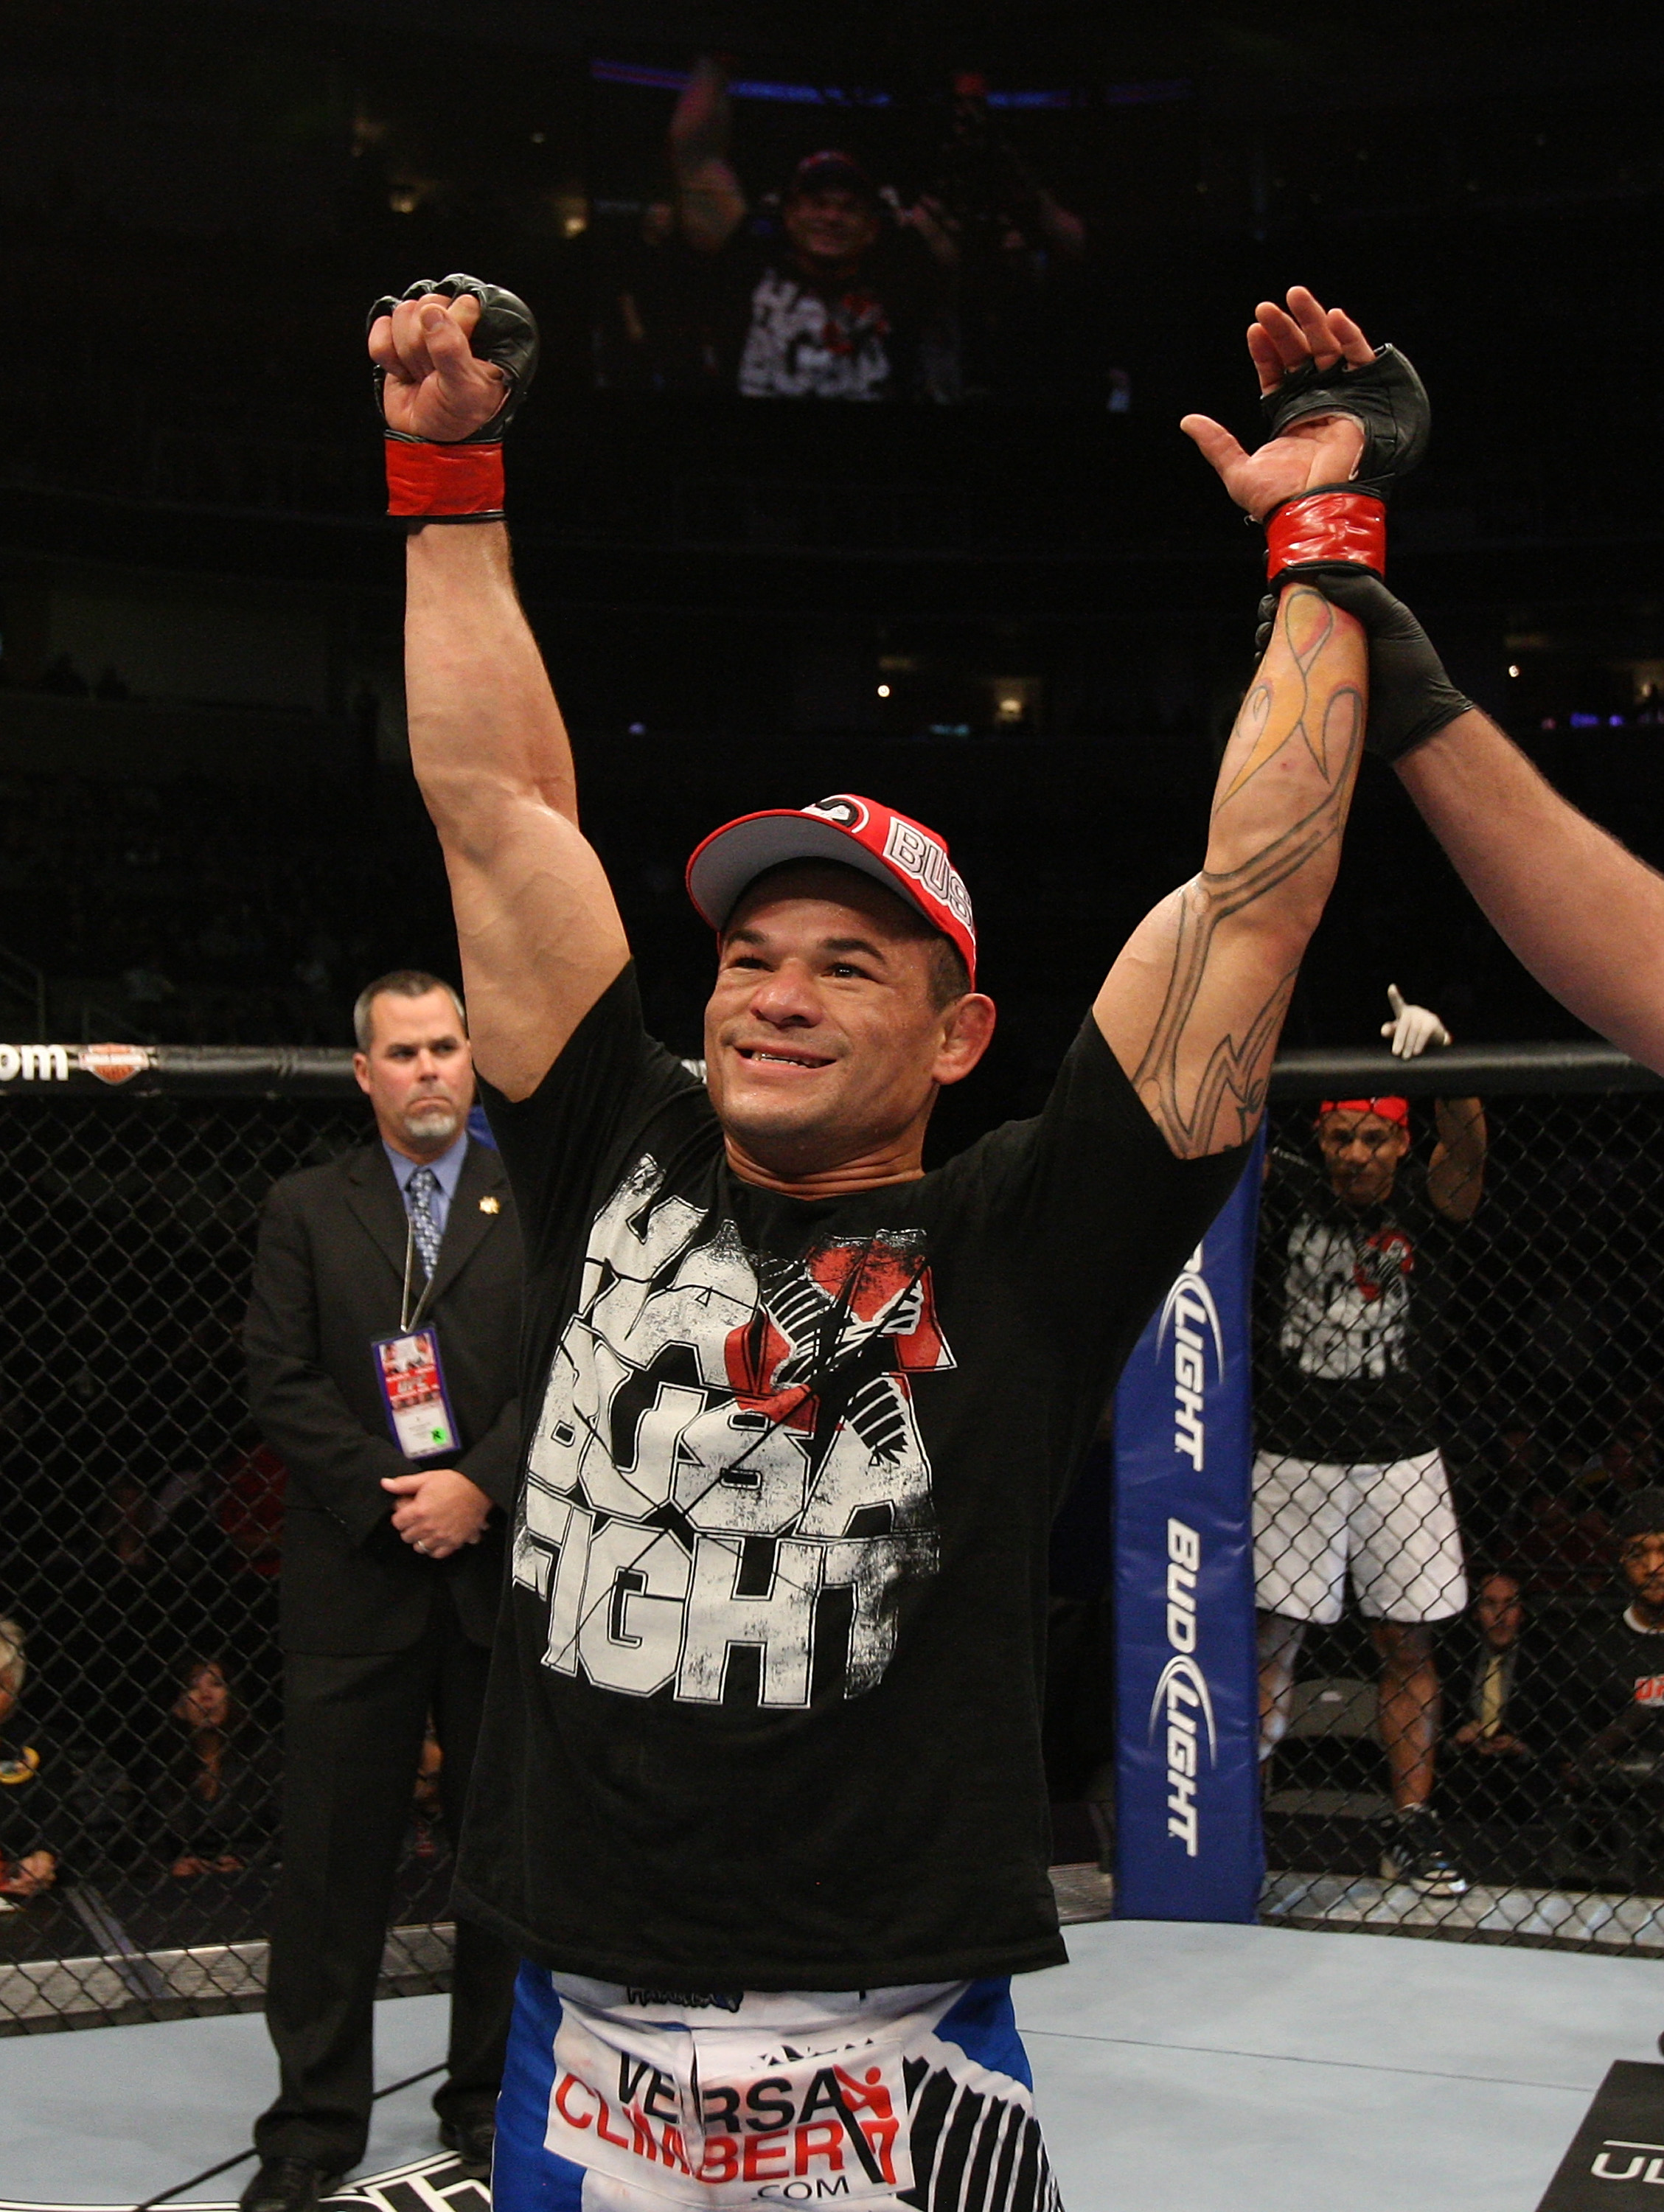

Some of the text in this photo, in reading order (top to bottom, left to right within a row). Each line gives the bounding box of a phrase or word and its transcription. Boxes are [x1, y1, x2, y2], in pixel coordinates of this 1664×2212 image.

[1175, 1294, 1206, 1472] LIGHT
[1167, 1517, 1200, 1857] BUD LIGHT
[618, 2051, 885, 2183] VERSA
[751, 2174, 849, 2200] .COM
